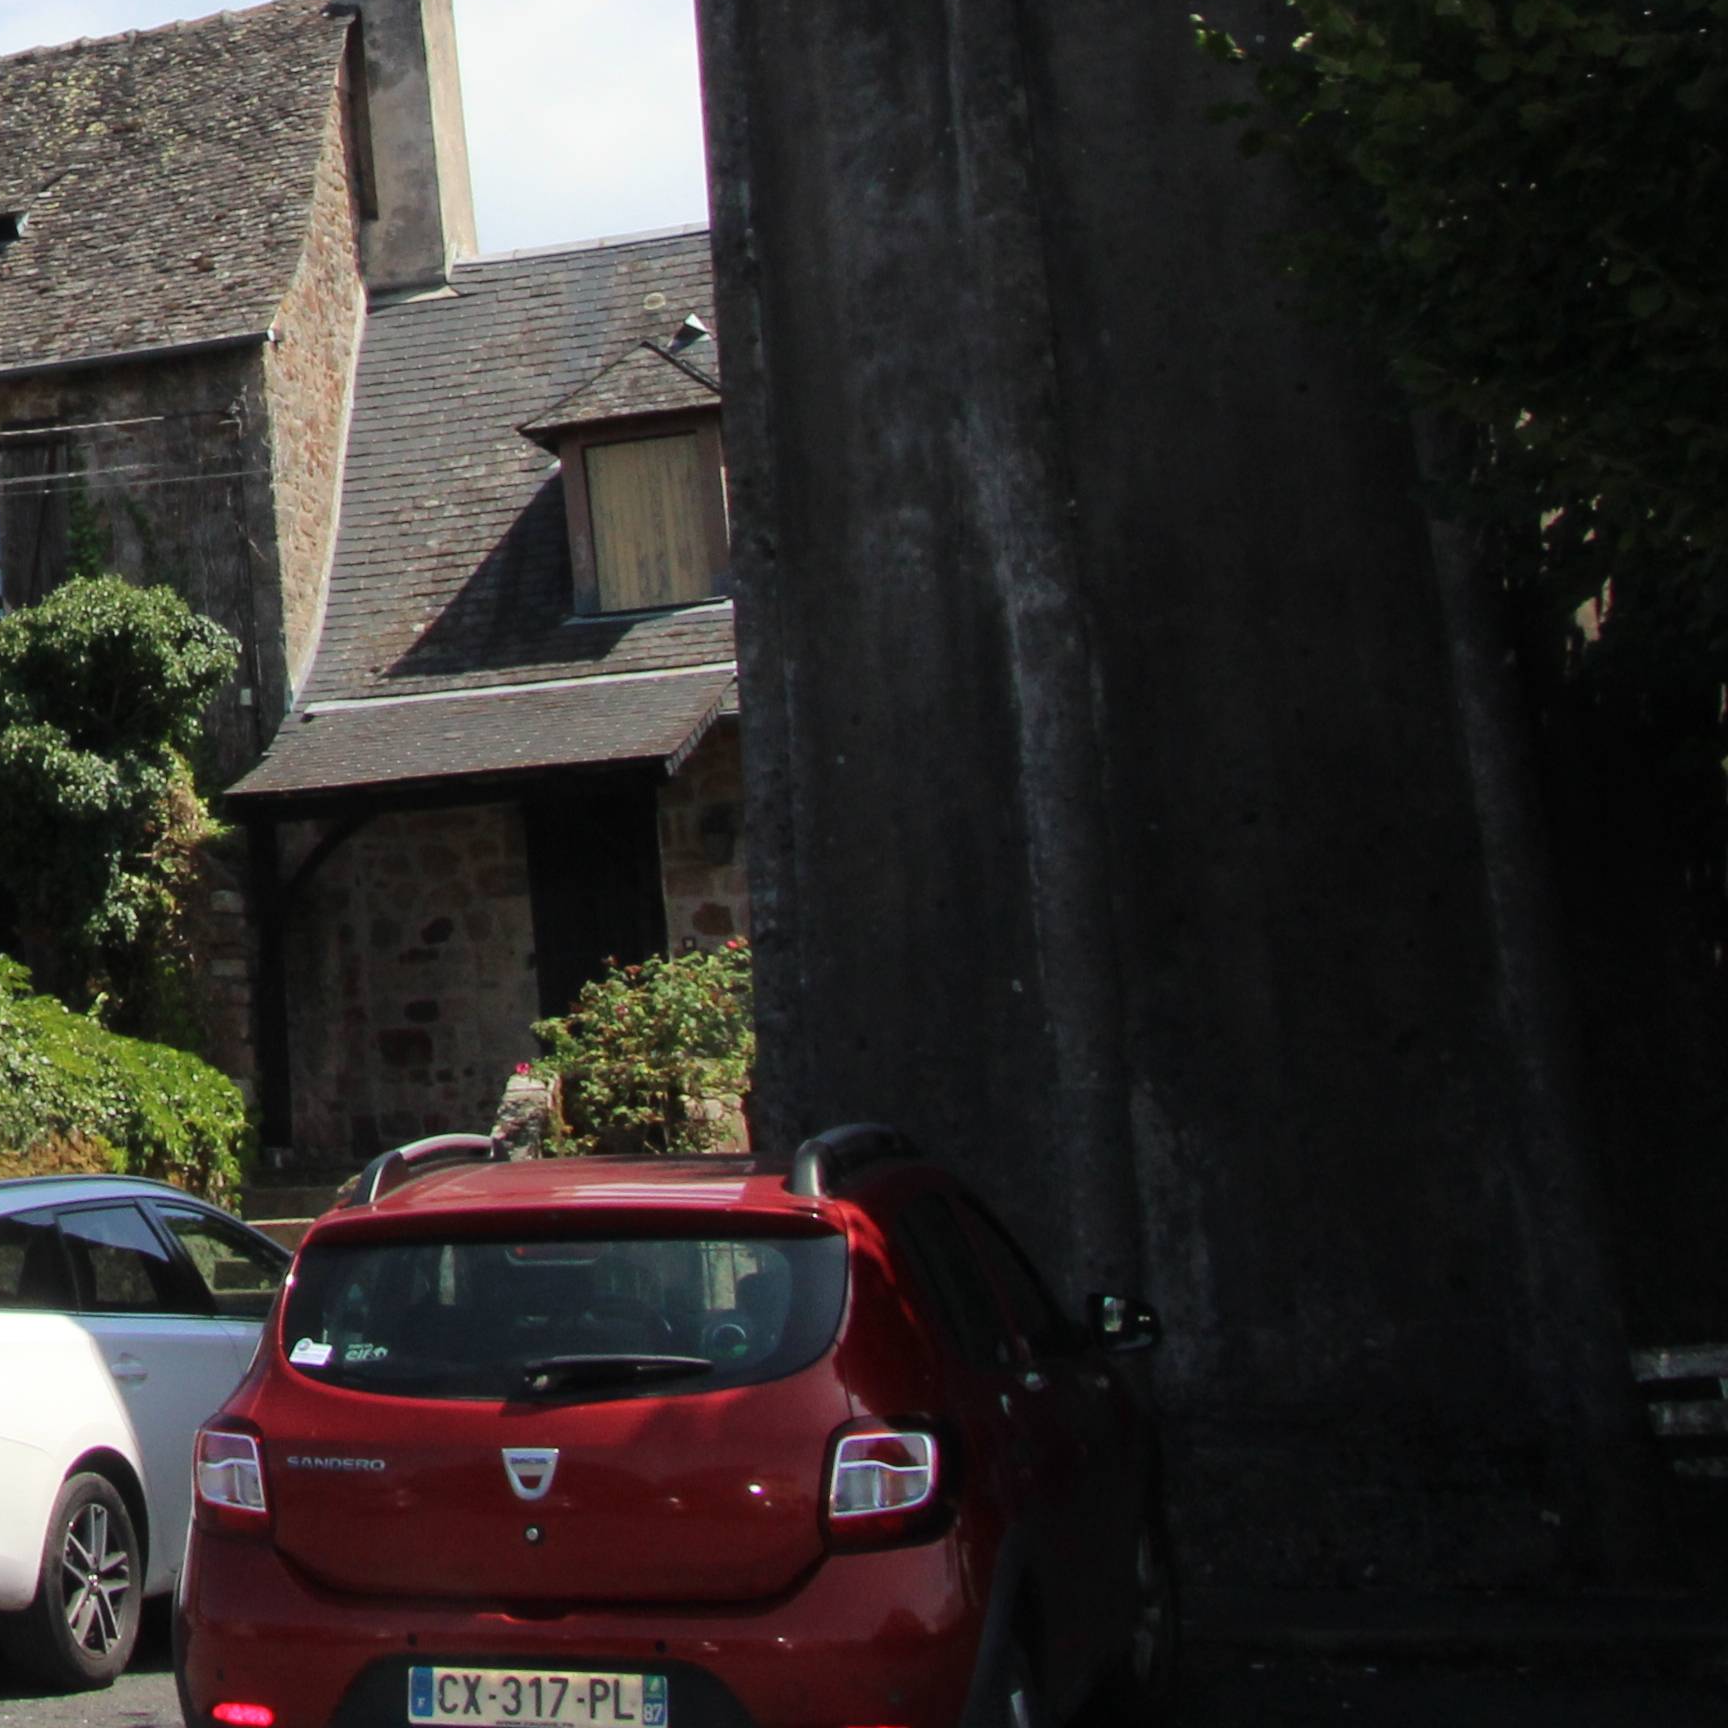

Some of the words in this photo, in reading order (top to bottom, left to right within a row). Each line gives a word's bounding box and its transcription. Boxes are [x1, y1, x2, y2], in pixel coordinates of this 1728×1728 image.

[287, 1456, 386, 1471] SANDERO
[438, 1674, 634, 1720] CX-317-PL
[644, 1704, 663, 1722] 87
